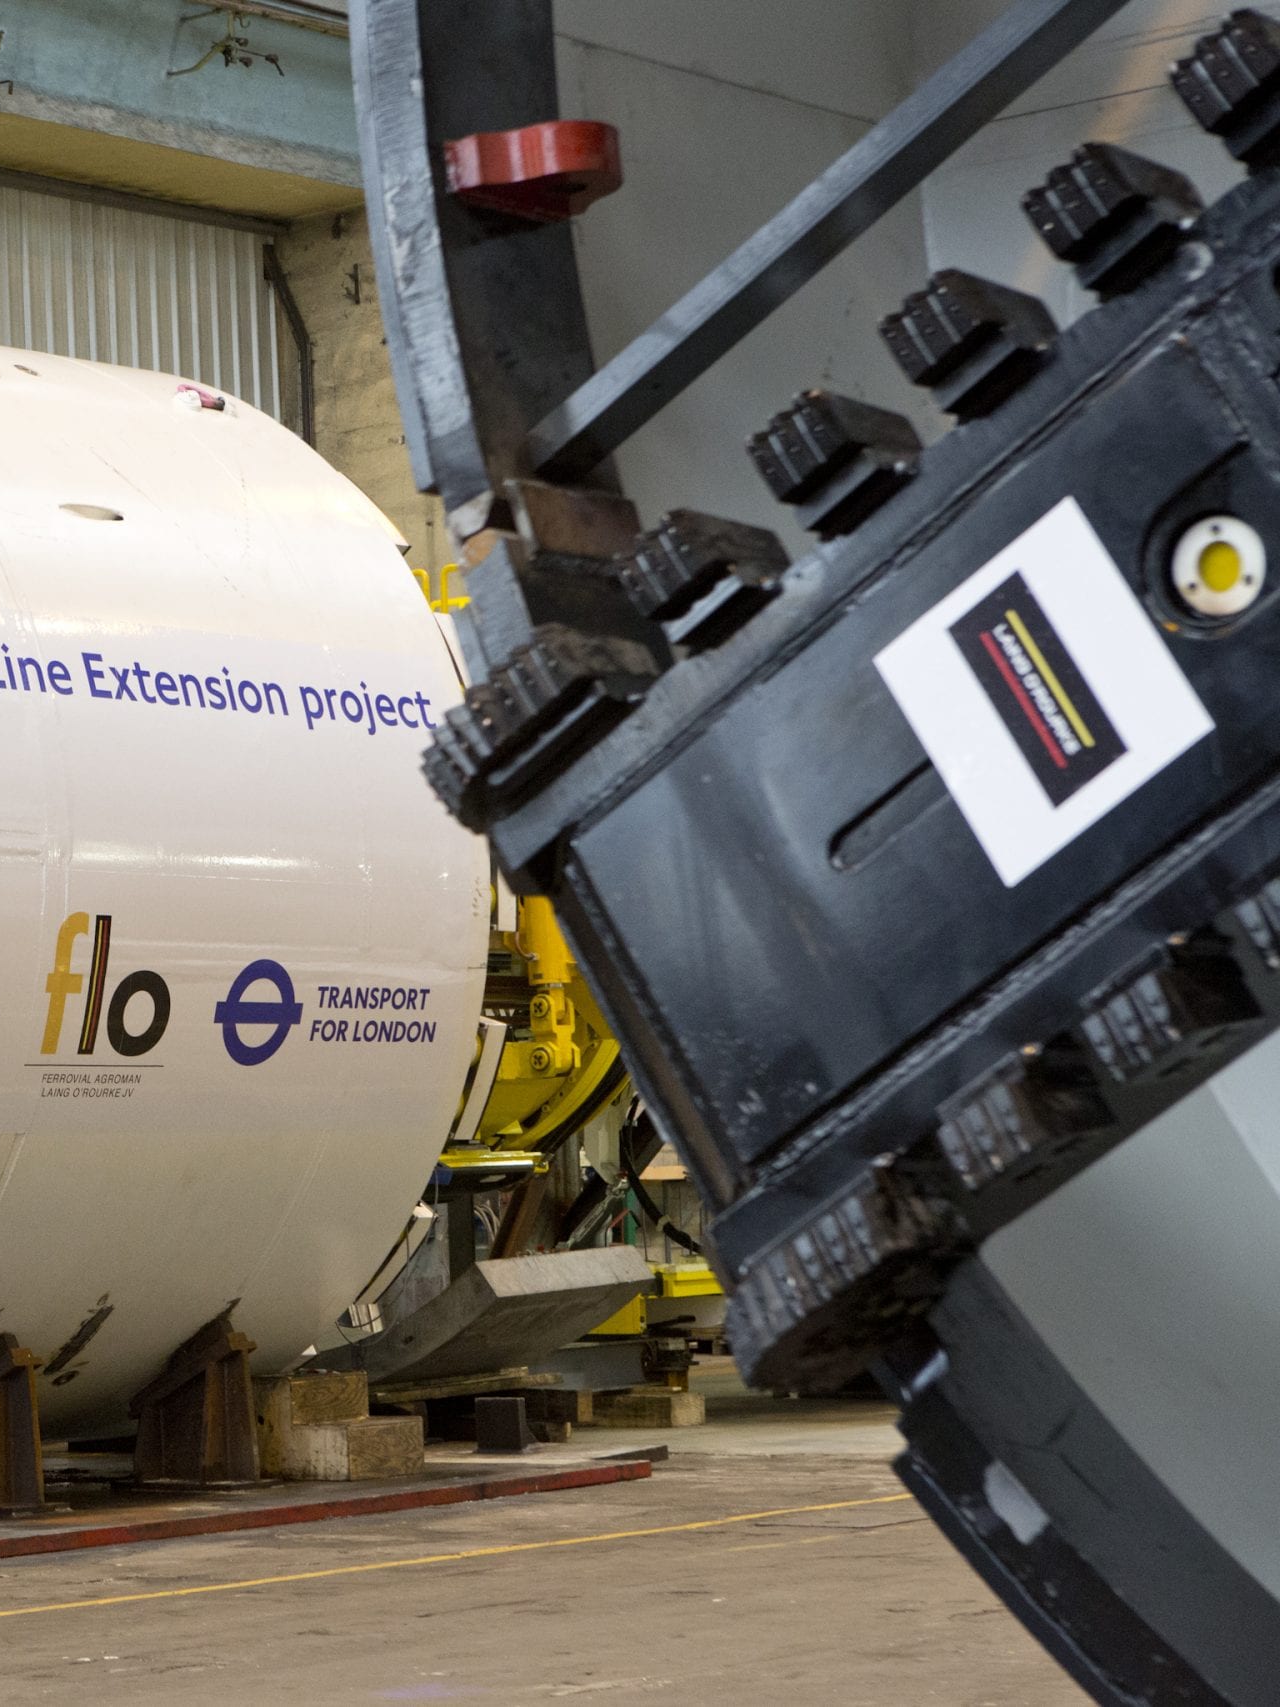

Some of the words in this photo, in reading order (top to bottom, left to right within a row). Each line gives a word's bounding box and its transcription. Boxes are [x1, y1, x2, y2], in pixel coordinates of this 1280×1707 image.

[81, 652, 289, 716] Extension
[299, 681, 437, 736] project
[40, 911, 171, 1057] flo
[318, 986, 430, 1010] TRANSPORT
[310, 1020, 348, 1042] FOR
[352, 1020, 436, 1042] LONDON
[41, 1074, 91, 1084] FERROVIAL
[94, 1074, 142, 1084] AGROMAN
[41, 1088, 70, 1098] LAING
[72, 1088, 121, 1098] O'ROURKE
[122, 1088, 134, 1098] JV
